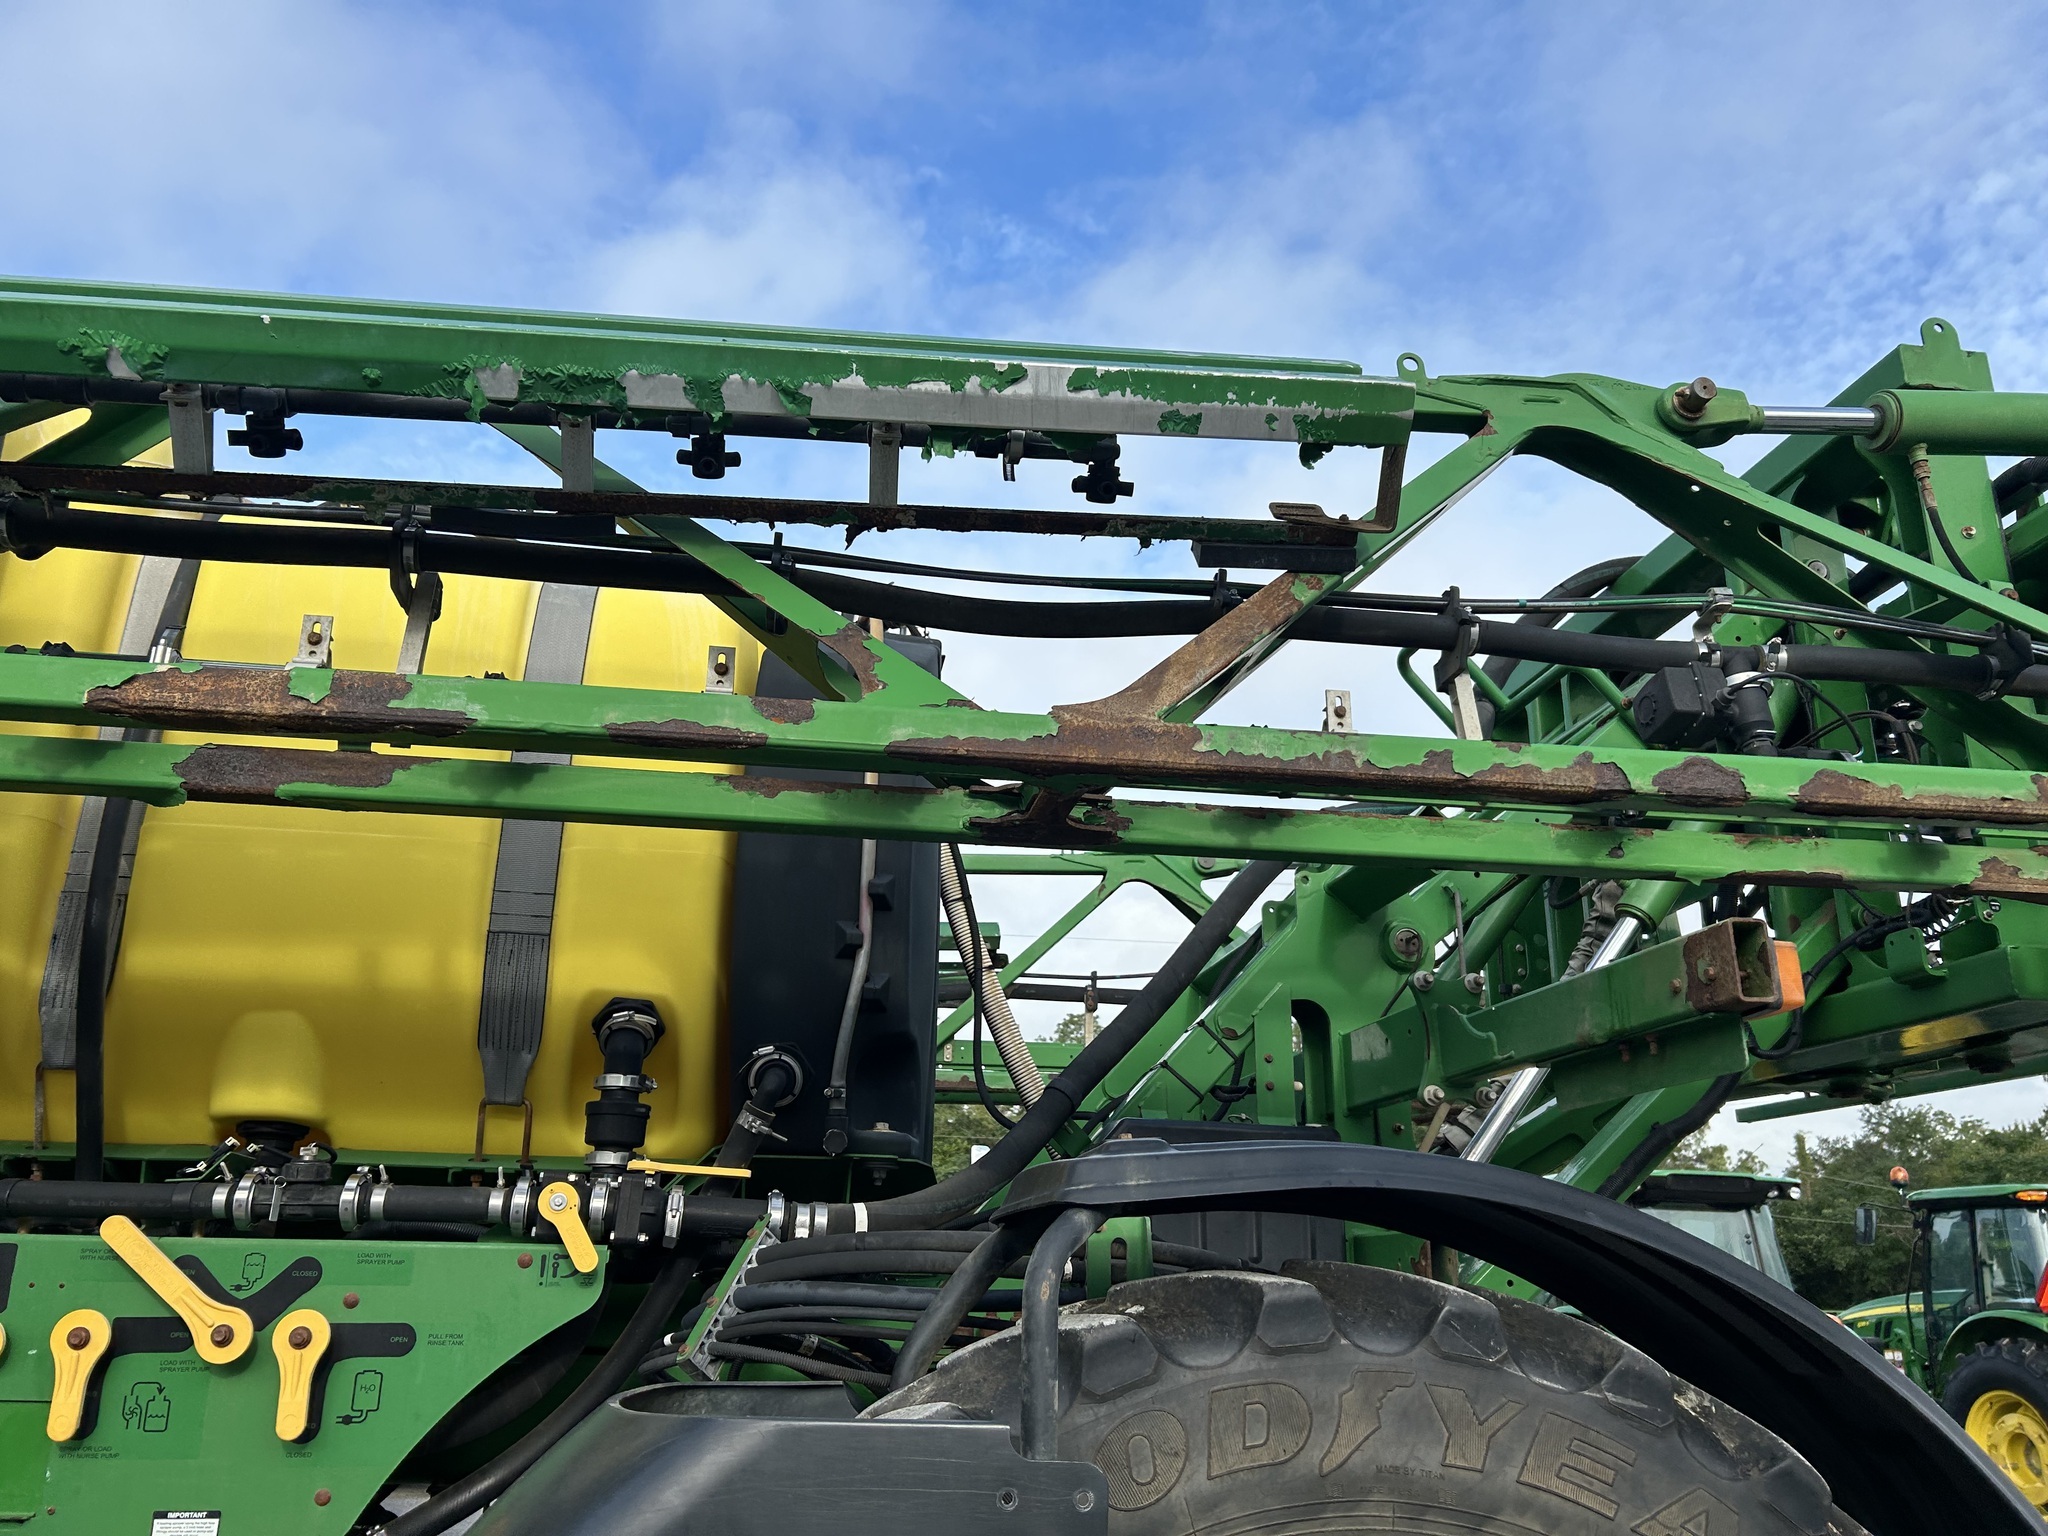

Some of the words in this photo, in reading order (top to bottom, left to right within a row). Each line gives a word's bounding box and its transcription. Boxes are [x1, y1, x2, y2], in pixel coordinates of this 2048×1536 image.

[1375, 1464, 1400, 1475] MADE
[1403, 1465, 1416, 1476] BY
[1419, 1468, 1446, 1481] TITAN
[167, 1511, 208, 1519] IMPORTANT
